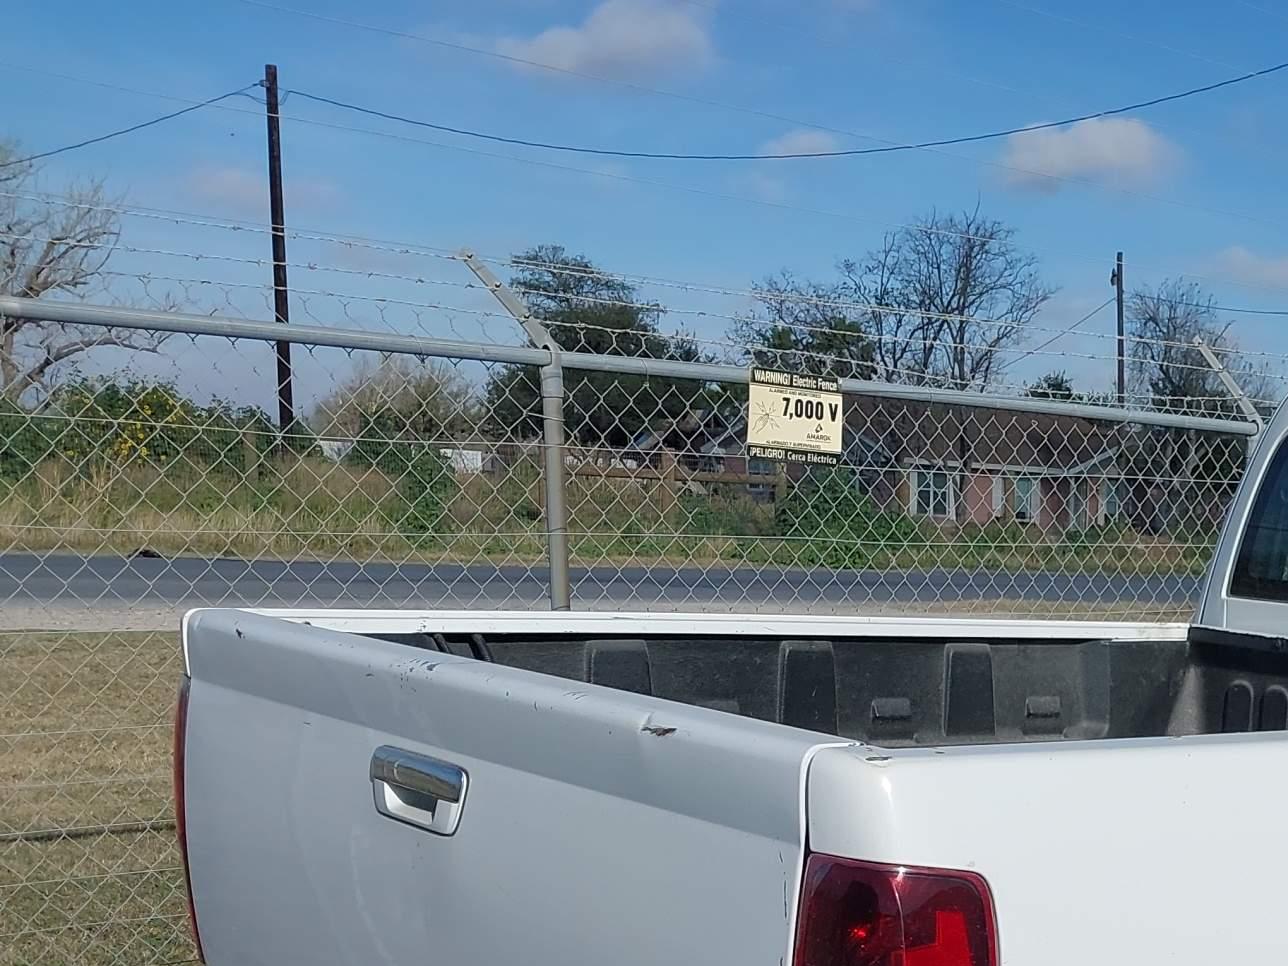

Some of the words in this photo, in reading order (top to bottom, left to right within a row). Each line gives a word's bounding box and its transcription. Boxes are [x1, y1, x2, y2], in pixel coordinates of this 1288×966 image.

[754, 369, 791, 385] WARNING!
[792, 375, 817, 389] Electric
[818, 378, 838, 391] Fence
[782, 397, 824, 420] 7,000
[828, 403, 838, 422] V
[806, 433, 832, 441] AMAROK
[750, 447, 785, 459] ¡PELIGRO!
[787, 452, 806, 462] Cerca
[807, 453, 837, 465] Eléctrica
